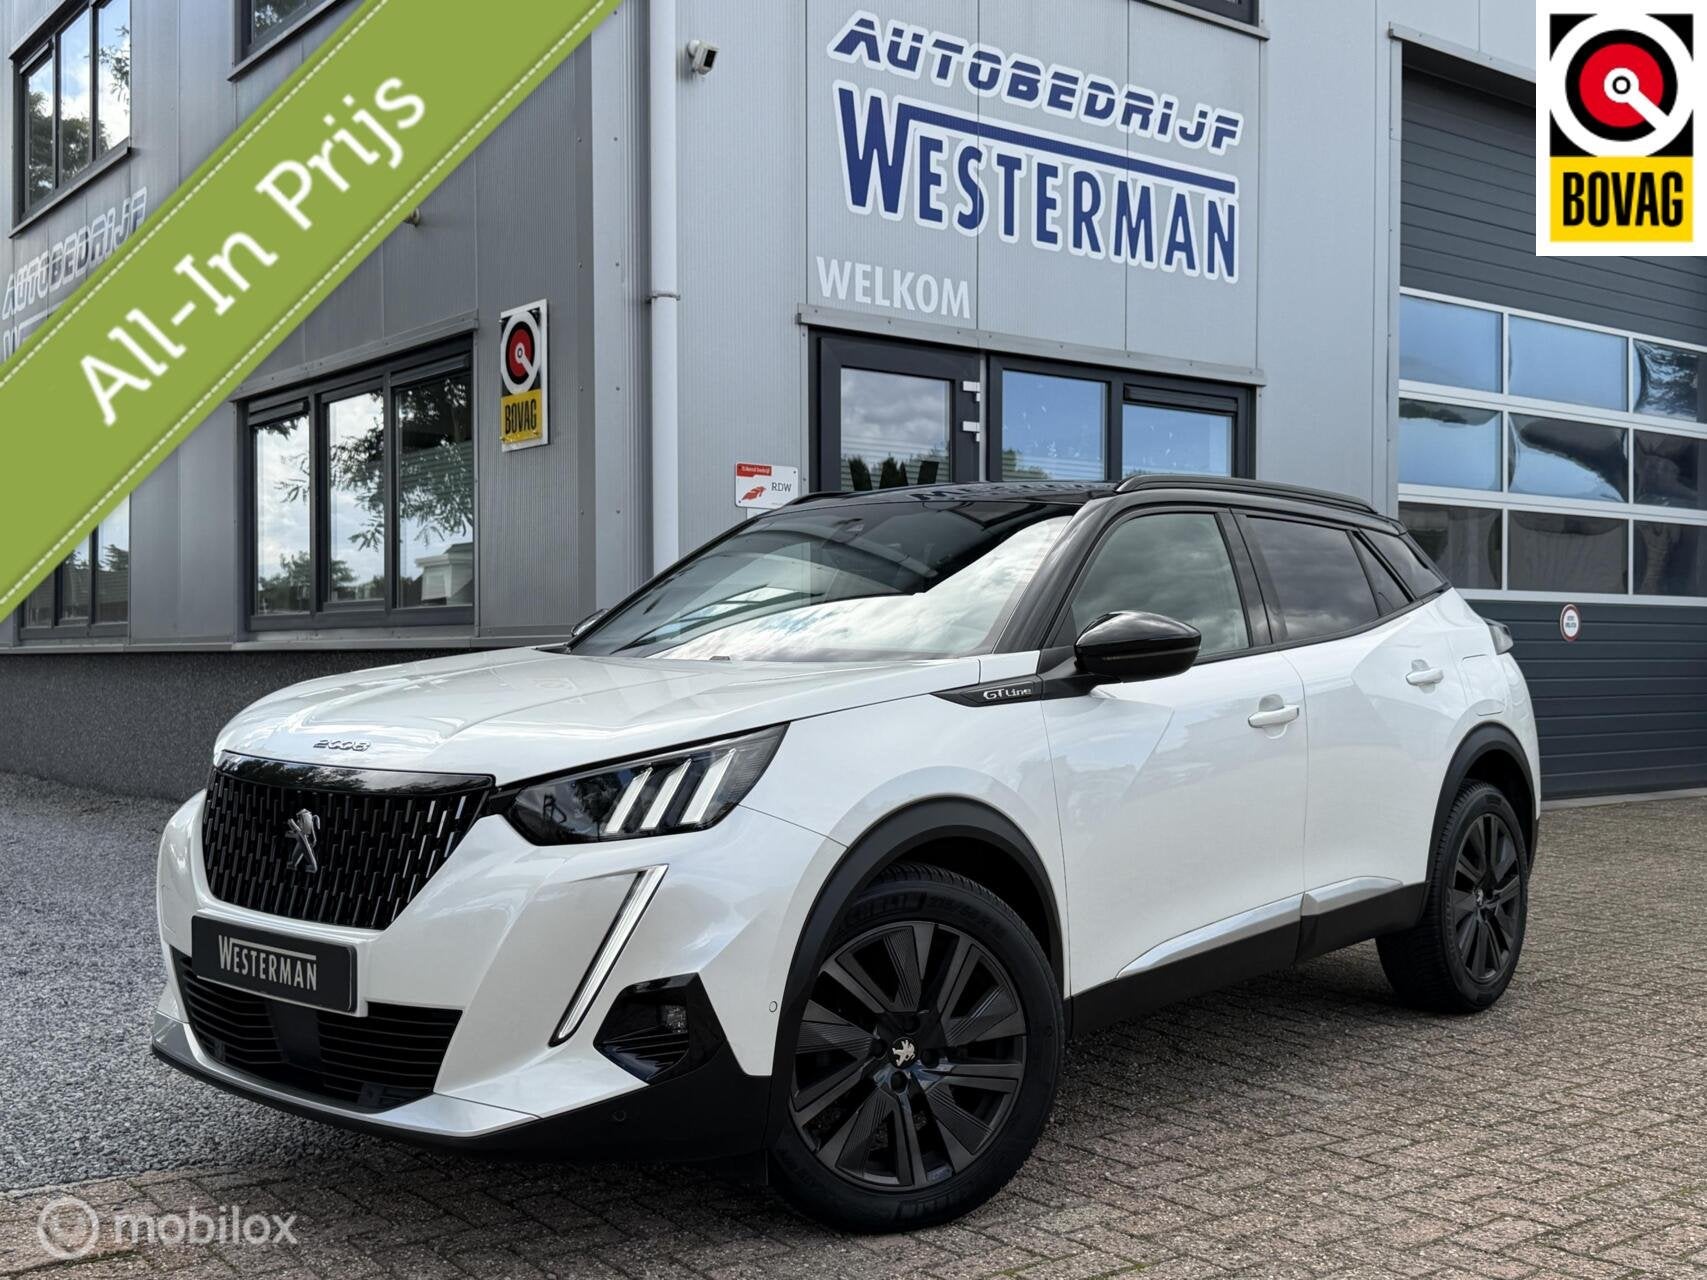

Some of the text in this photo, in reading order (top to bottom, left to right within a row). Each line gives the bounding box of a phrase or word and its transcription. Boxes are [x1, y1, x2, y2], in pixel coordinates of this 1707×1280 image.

[829, 11, 1243, 153] AUTOBEDRIJF
[834, 82, 1238, 281] WESTERMAN
[815, 256, 971, 319] WELKOM
[504, 398, 537, 435] BOVAG
[771, 482, 792, 493] RDW
[313, 738, 371, 752] 2008
[218, 934, 317, 991] WESTERMAN
